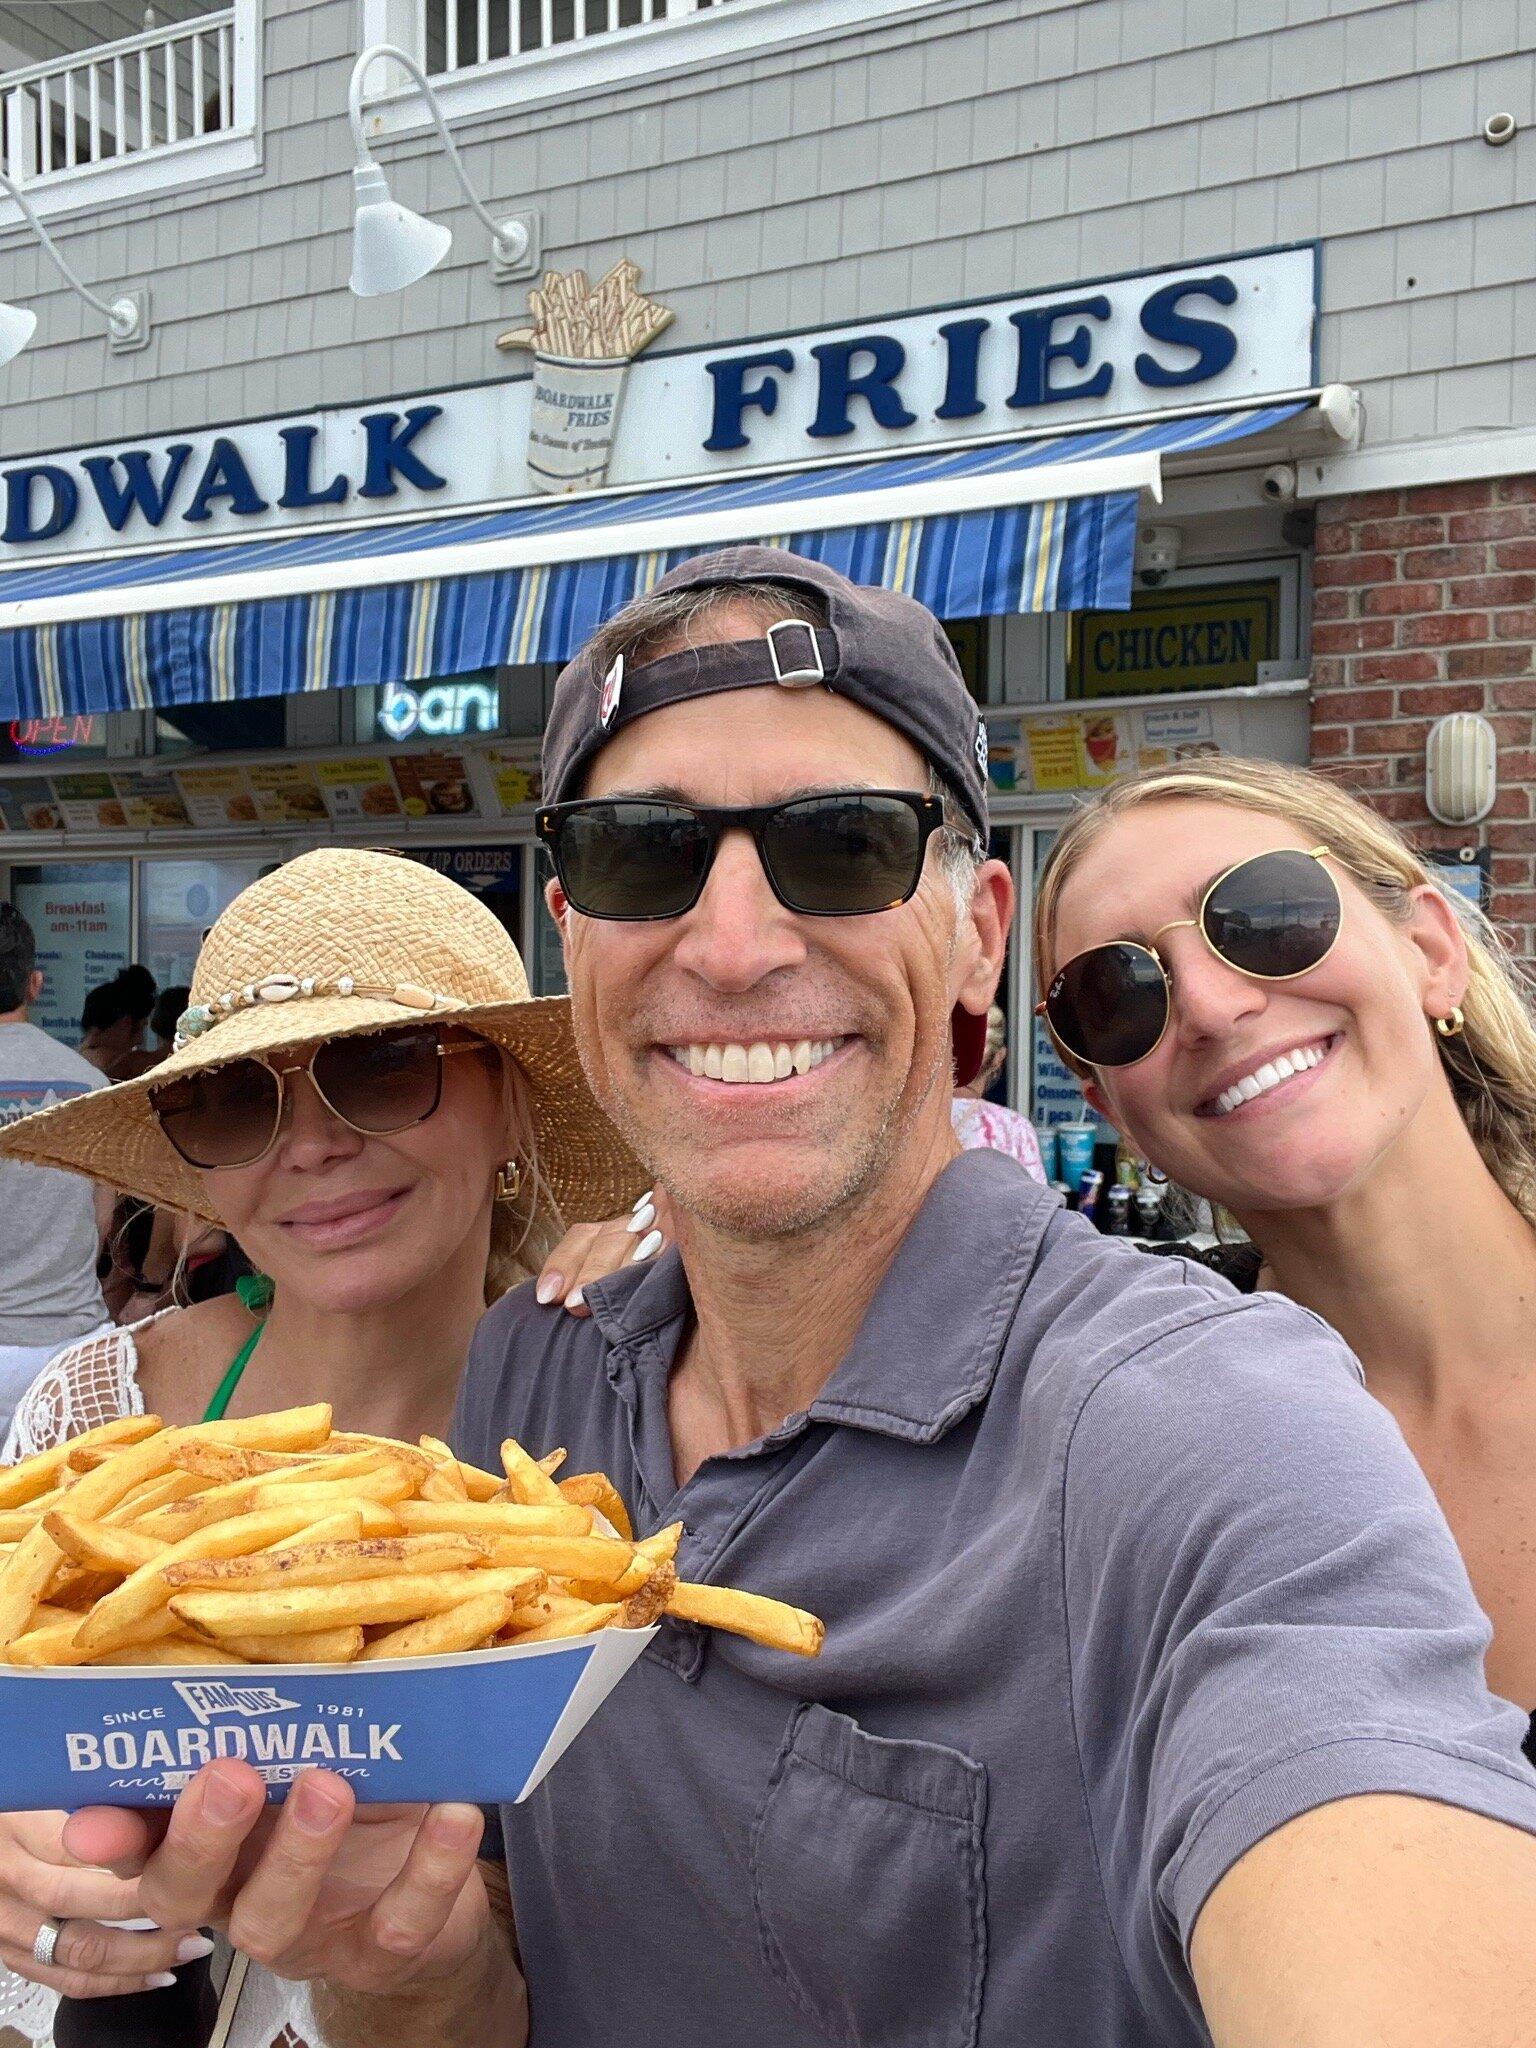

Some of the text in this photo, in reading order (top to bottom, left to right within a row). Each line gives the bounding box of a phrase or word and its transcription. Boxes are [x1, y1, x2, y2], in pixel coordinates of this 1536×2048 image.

[1, 274, 1238, 544] DWALK FRIES
[535, 384, 615, 410] BOARDWALK
[567, 410, 613, 428] FRIES
[1094, 618, 1252, 674] CHICKEN
[9, 715, 94, 745] OPEN
[454, 850, 512, 873] ORDERS
[45, 901, 106, 916] Breakfast
[186, 1681, 280, 1712] FAMOUS
[102, 1703, 365, 1726] SINCE 1981
[65, 1723, 403, 1772] BOARDWALK
